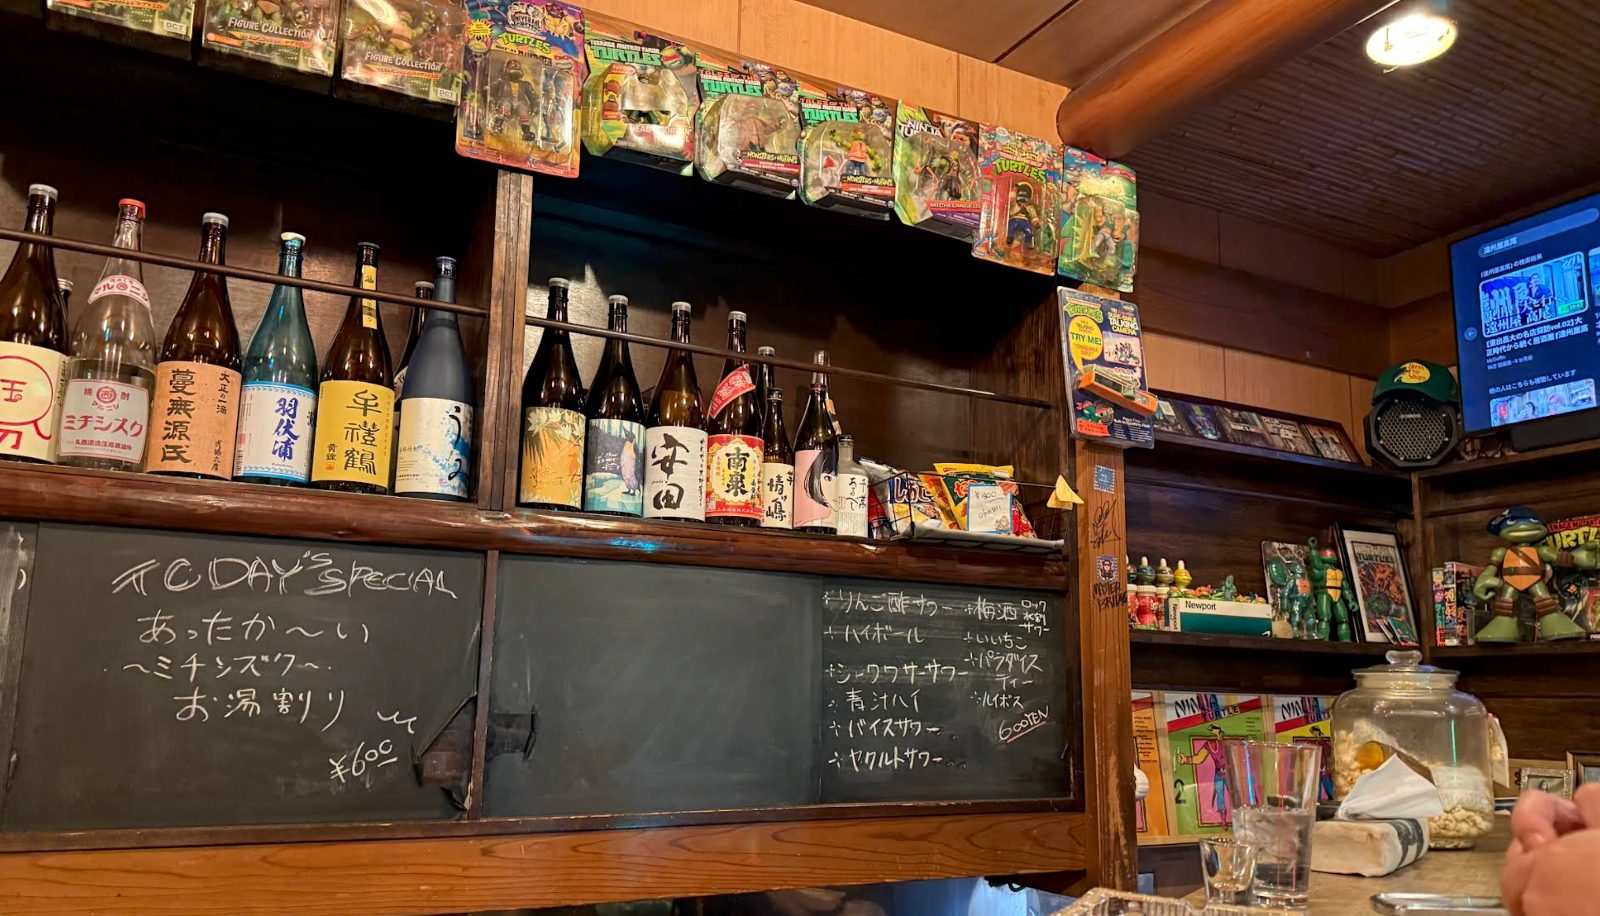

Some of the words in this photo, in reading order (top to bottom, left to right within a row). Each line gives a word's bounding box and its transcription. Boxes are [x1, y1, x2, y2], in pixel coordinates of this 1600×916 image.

[228, 17, 259, 31] FIGURE
[261, 23, 314, 39] COLLECTION
[499, 32, 551, 55] TURTLES
[591, 45, 662, 66] TURTLES
[365, 51, 393, 64] FIGURE
[395, 56, 441, 72] COLLECTION
[702, 79, 763, 97] TURTLES
[802, 108, 859, 123] TURTLES
[906, 118, 943, 136] NINJA
[992, 157, 1047, 183] TURTLES
[1070, 331, 1087, 342] TRY
[1087, 335, 1102, 346] ME!
[216, 371, 231, 415] 大正の一滴
[63, 414, 144, 438] ミチシズク
[161, 368, 197, 463] 蔓無源氏
[272, 396, 300, 462] 羽伏浦
[651, 433, 690, 510] 安田
[724, 446, 751, 497] 南泉
[304, 560, 459, 599] SPECIAL
[839, 589, 953, 617] りんご酢サワー
[974, 595, 1017, 621] 梅酒
[1185, 600, 1216, 611] Newport
[845, 622, 924, 644] ハイボール
[976, 632, 1028, 650] いいちこ
[979, 650, 1044, 674] パラダイス
[995, 674, 1033, 691] ティー
[173, 687, 345, 732] お湯割り
[846, 687, 921, 713] 青汁ハイ
[983, 691, 1025, 711] ルイボス
[1174, 693, 1219, 718] NINJA
[1281, 696, 1321, 720] NINJA
[1201, 704, 1240, 722] TURTLE
[848, 718, 941, 738] バイスサワー
[329, 739, 398, 783] ¥600
[849, 746, 943, 773] ヤクルトサワー
[1174, 779, 1187, 805] 2
